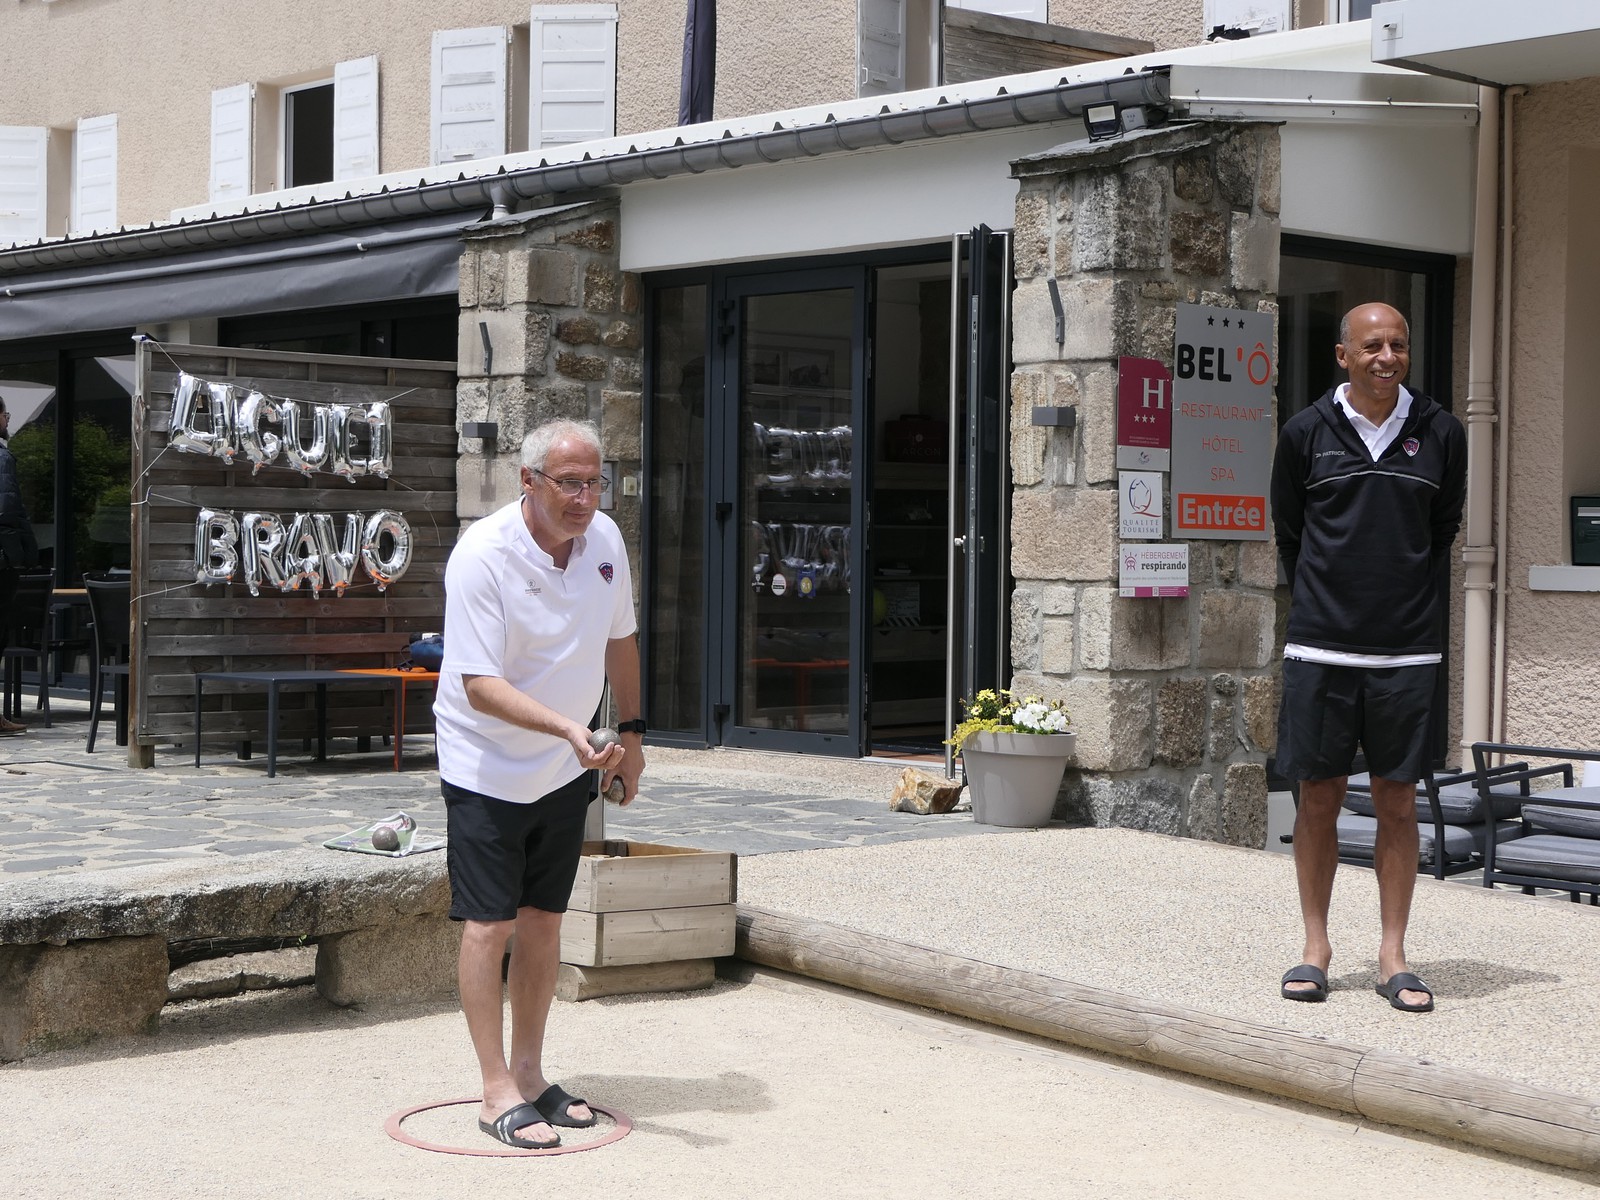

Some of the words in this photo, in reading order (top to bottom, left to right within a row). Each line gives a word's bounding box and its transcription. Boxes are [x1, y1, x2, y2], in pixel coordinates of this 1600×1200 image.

[1141, 377, 1166, 409] H
[1181, 402, 1264, 422] RESTAURANT
[1202, 434, 1243, 453] HÔTEL
[1210, 467, 1235, 482] SPA
[1182, 498, 1261, 527] Entrée
[1122, 526, 1159, 534] TOURISME
[194, 507, 413, 599] BRAVO
[1141, 560, 1187, 572] respirando
